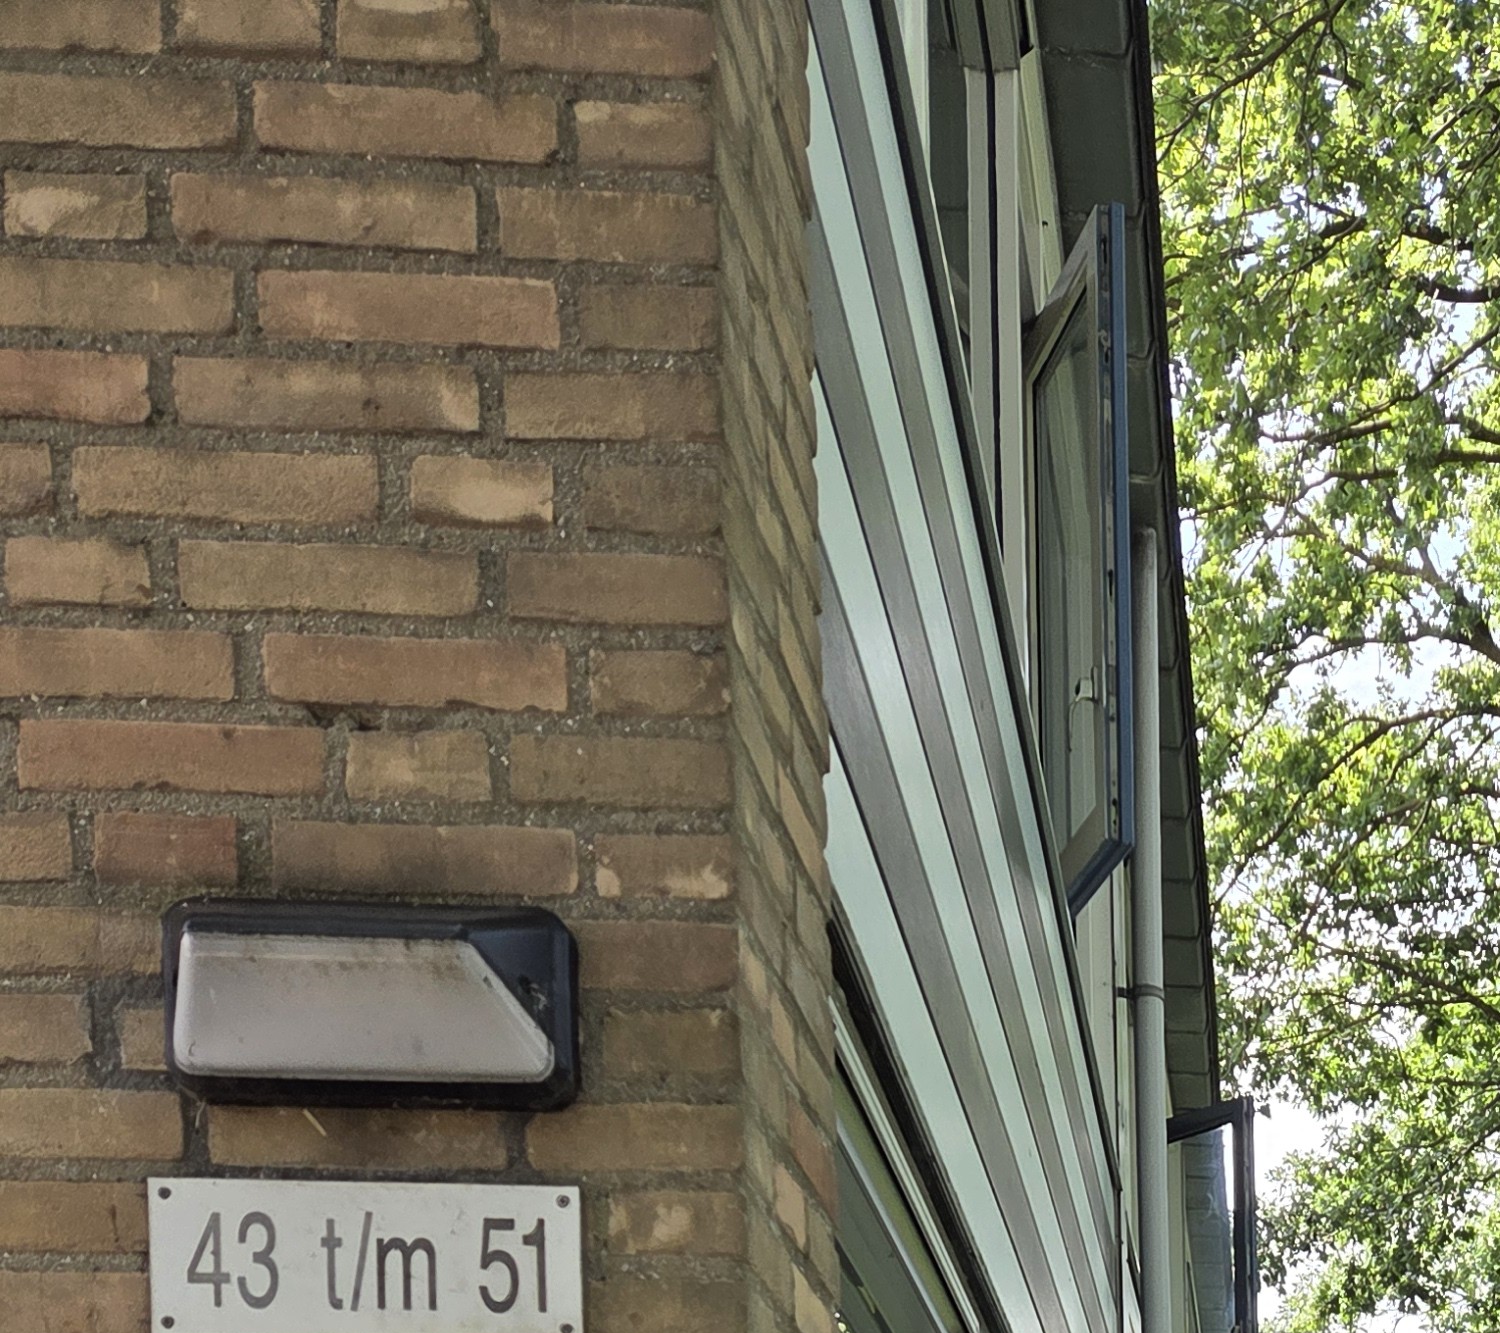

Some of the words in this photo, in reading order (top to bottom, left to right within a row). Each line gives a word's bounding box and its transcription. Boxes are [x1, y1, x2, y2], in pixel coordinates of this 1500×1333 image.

[187, 1211, 279, 1309] 43
[320, 1211, 438, 1312] t/m
[478, 1217, 547, 1314] 51
